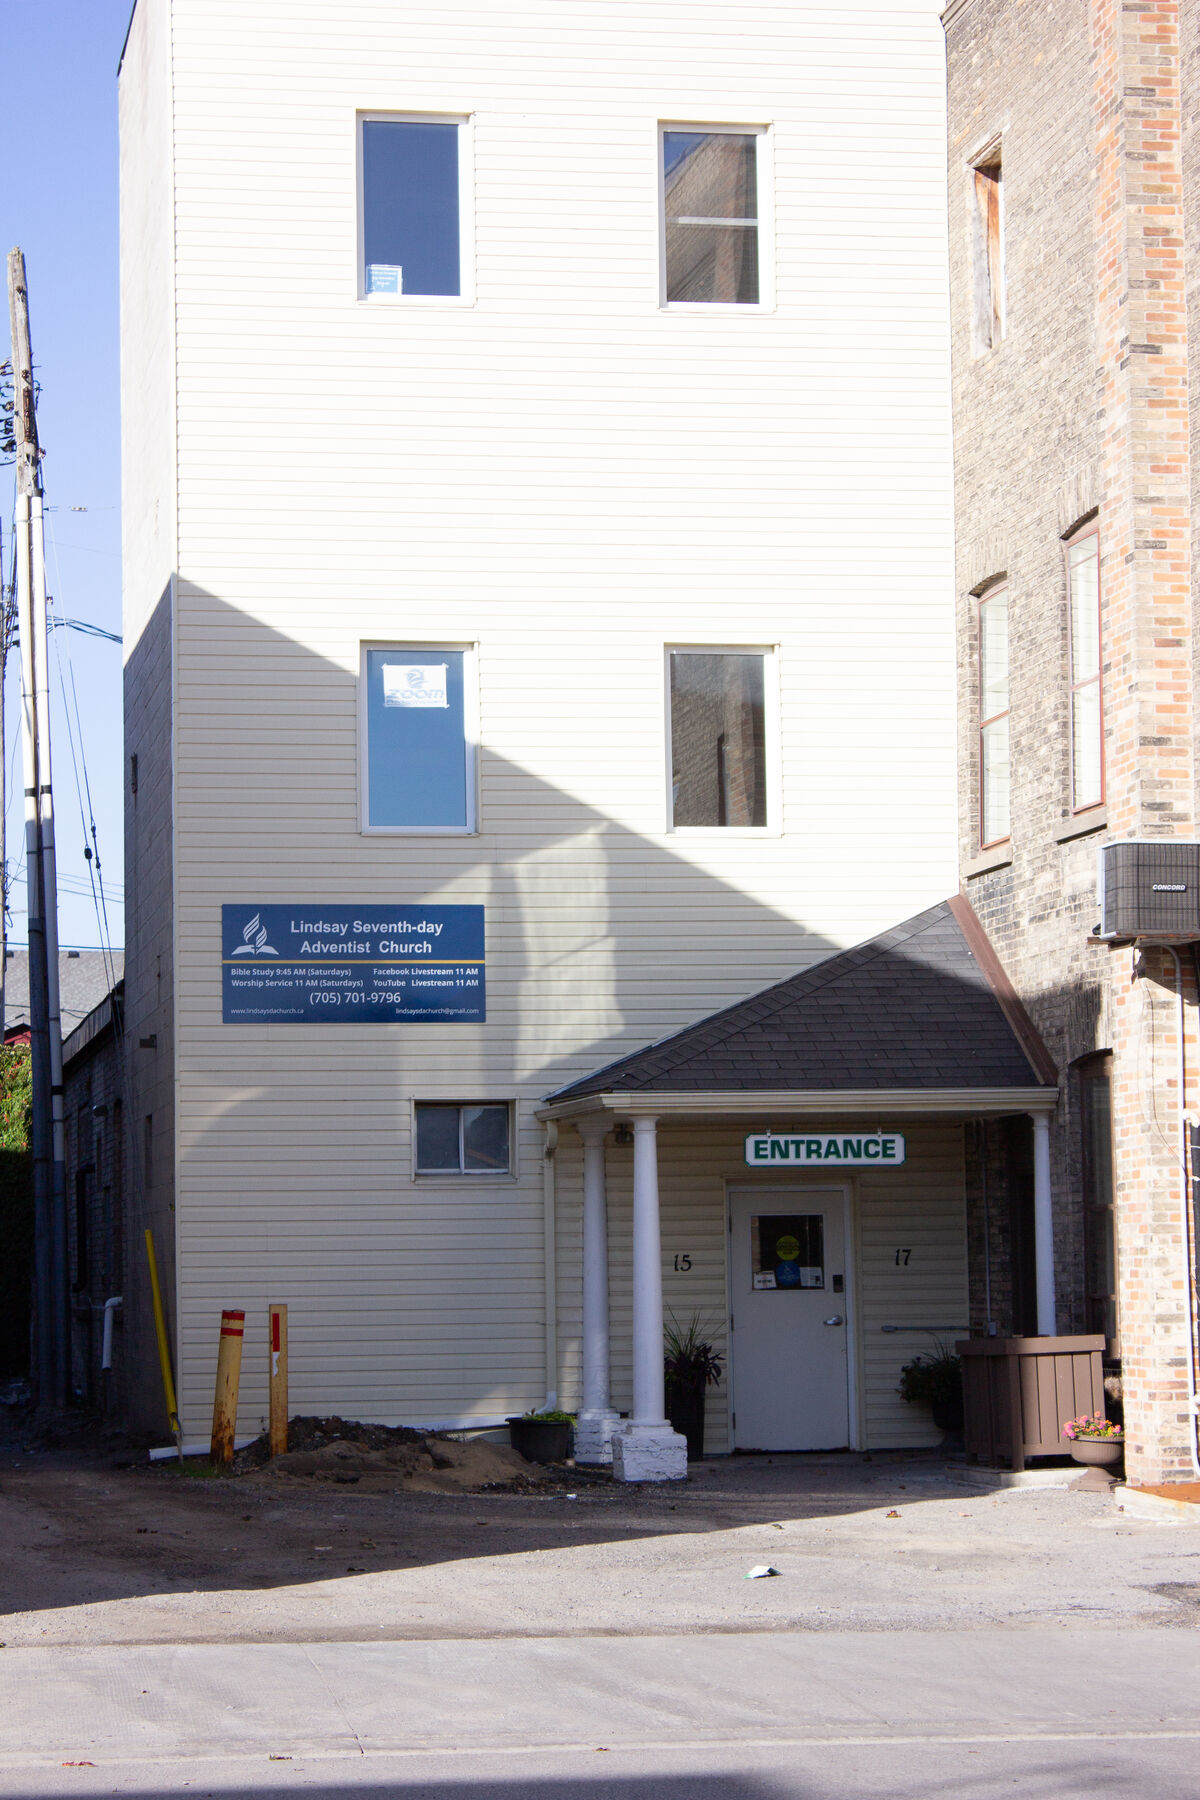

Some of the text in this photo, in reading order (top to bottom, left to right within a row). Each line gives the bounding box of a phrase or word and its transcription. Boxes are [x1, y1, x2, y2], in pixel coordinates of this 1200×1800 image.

[290, 920, 444, 936] Lindsay Seventh-day
[300, 940, 432, 954] Adventist Church
[231, 968, 352, 978] Bible Study 9:45 AM (Saturdays)
[373, 968, 410, 976] Facebook
[411, 968, 454, 976] Livestream
[231, 979, 364, 988] Worship Service 11 AM (Saturdays)
[373, 979, 479, 987] YouTube Livestream 11 AM
[309, 992, 401, 1005] (705) 701-9796
[230, 1007, 304, 1015] www.lindsaysdachurch.ca
[395, 1007, 479, 1016] lindsaysdachurch@gmail.com
[753, 1139, 896, 1159] ENTRANCE
[673, 1254, 692, 1272] 15
[895, 1249, 912, 1266] 17
